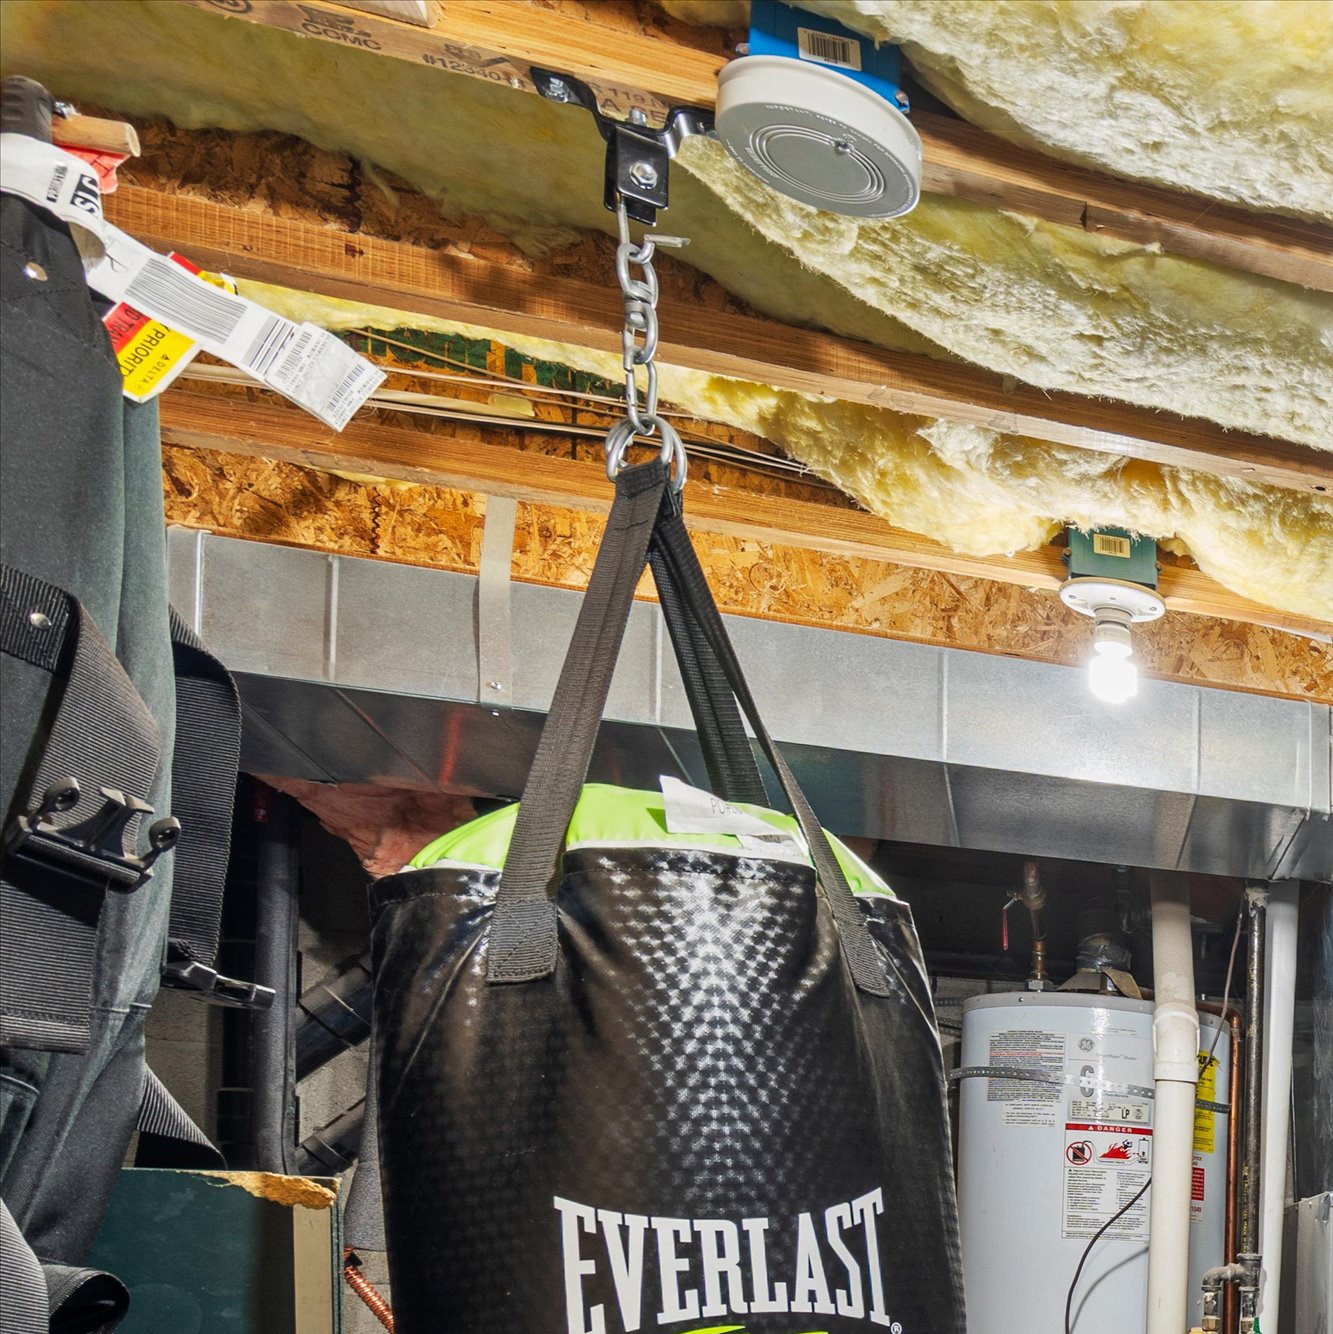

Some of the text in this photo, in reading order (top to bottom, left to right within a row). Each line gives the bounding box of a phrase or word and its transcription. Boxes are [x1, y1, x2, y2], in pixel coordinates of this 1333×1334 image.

[301, 22, 382, 52] CCMC
[143, 359, 170, 385] DELTA
[1120, 1108, 1131, 1121] LP
[1096, 1124, 1134, 1134] DANGER
